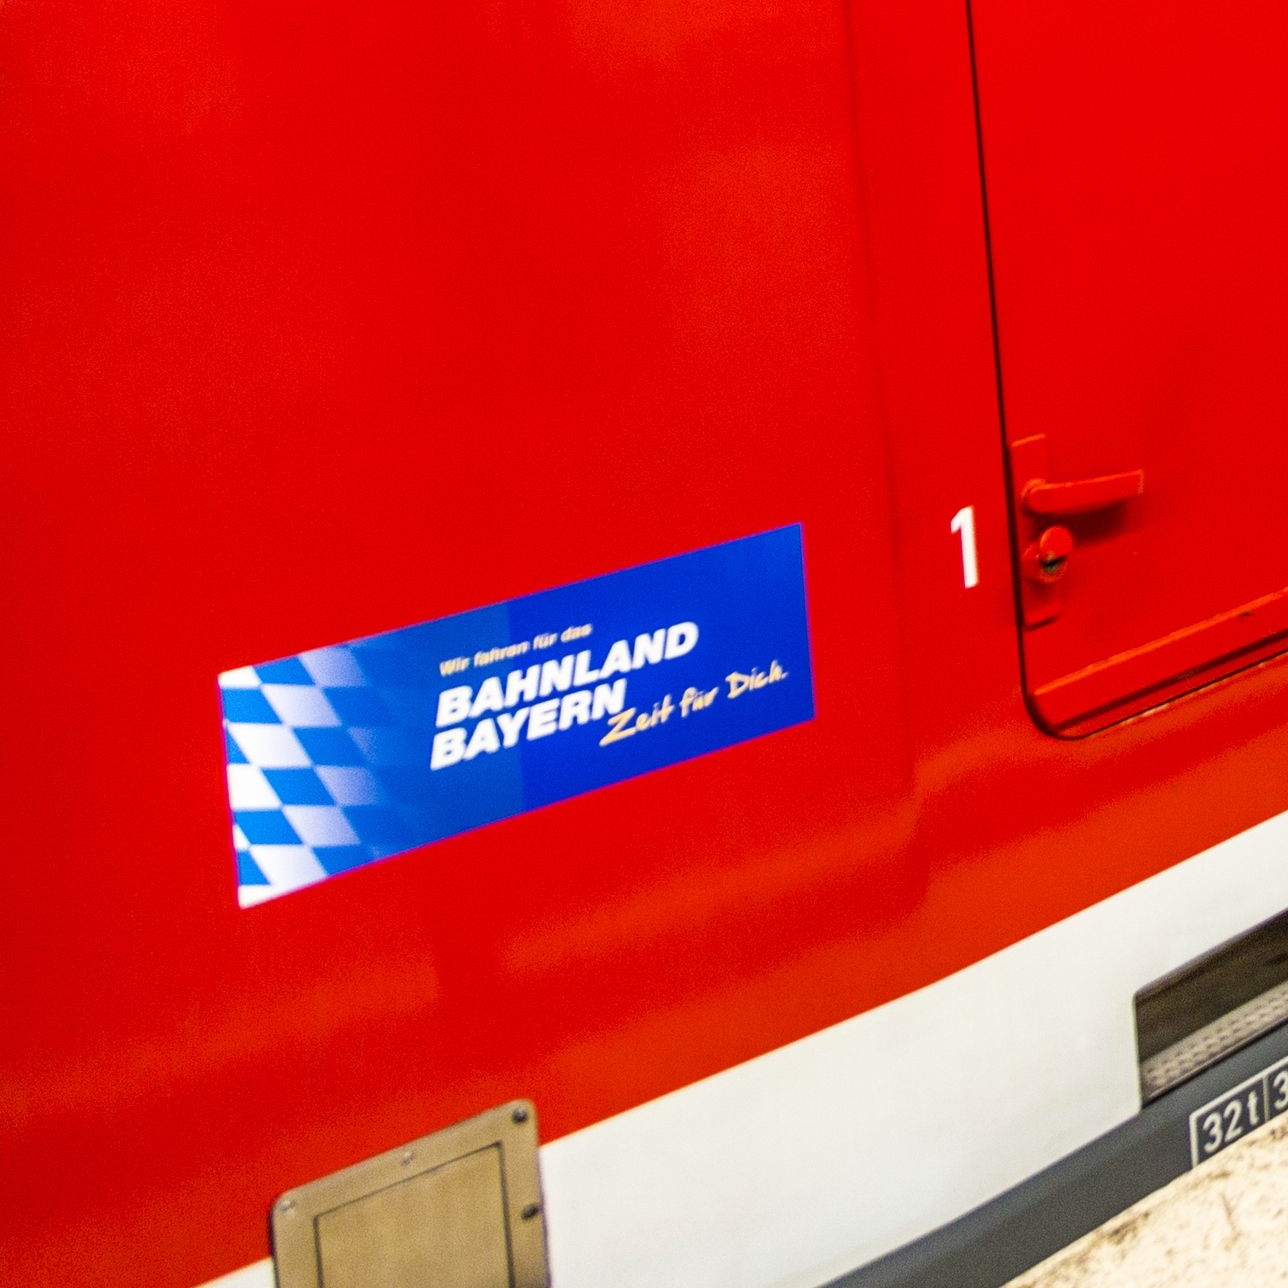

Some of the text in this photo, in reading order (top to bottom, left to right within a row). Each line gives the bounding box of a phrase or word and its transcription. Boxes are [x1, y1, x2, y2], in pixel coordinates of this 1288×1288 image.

[950, 505, 979, 589] 1
[436, 622, 699, 728] BAHNLAND
[440, 623, 592, 676] Wir fahren für das
[430, 678, 628, 771] BAYERN
[599, 660, 790, 747] Zeit für Dich.
